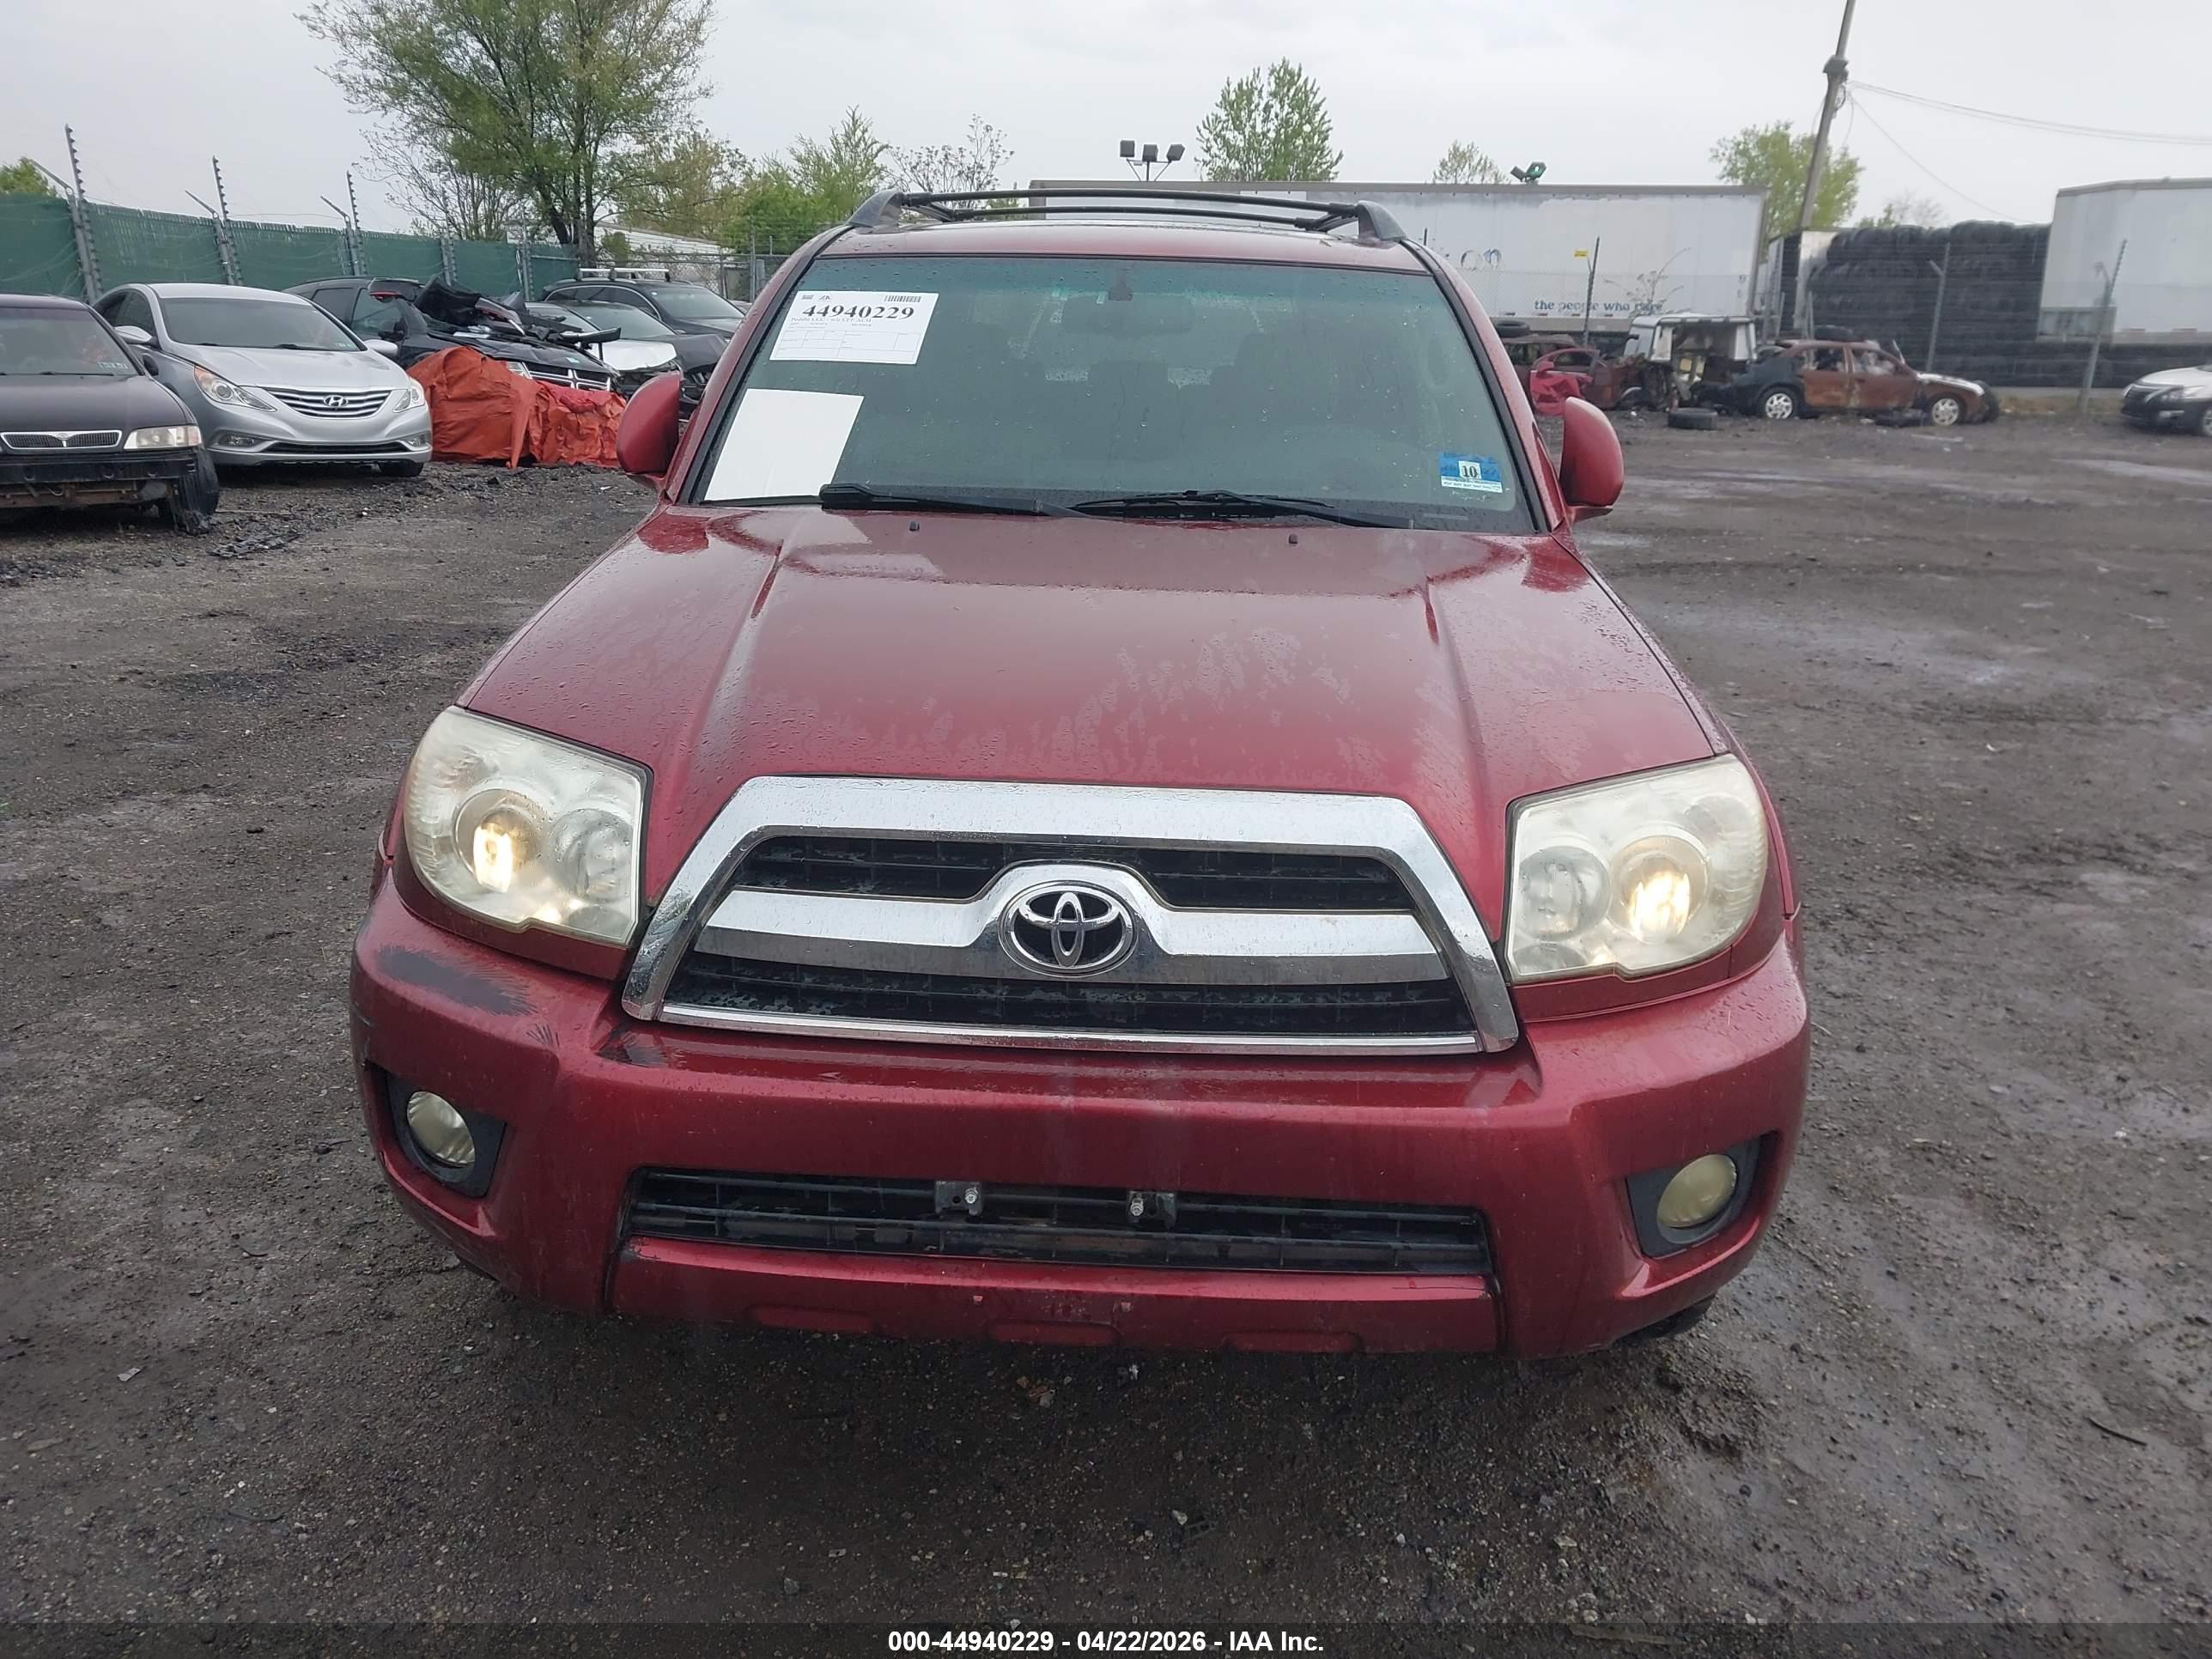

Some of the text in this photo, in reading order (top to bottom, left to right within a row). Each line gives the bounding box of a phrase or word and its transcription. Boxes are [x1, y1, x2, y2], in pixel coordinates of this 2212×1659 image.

[802, 305, 915, 320] 44940229
[1534, 300, 1555, 310] the
[1558, 301, 1600, 313] peope
[1603, 301, 1630, 311] who
[1462, 465, 1478, 478] 10
